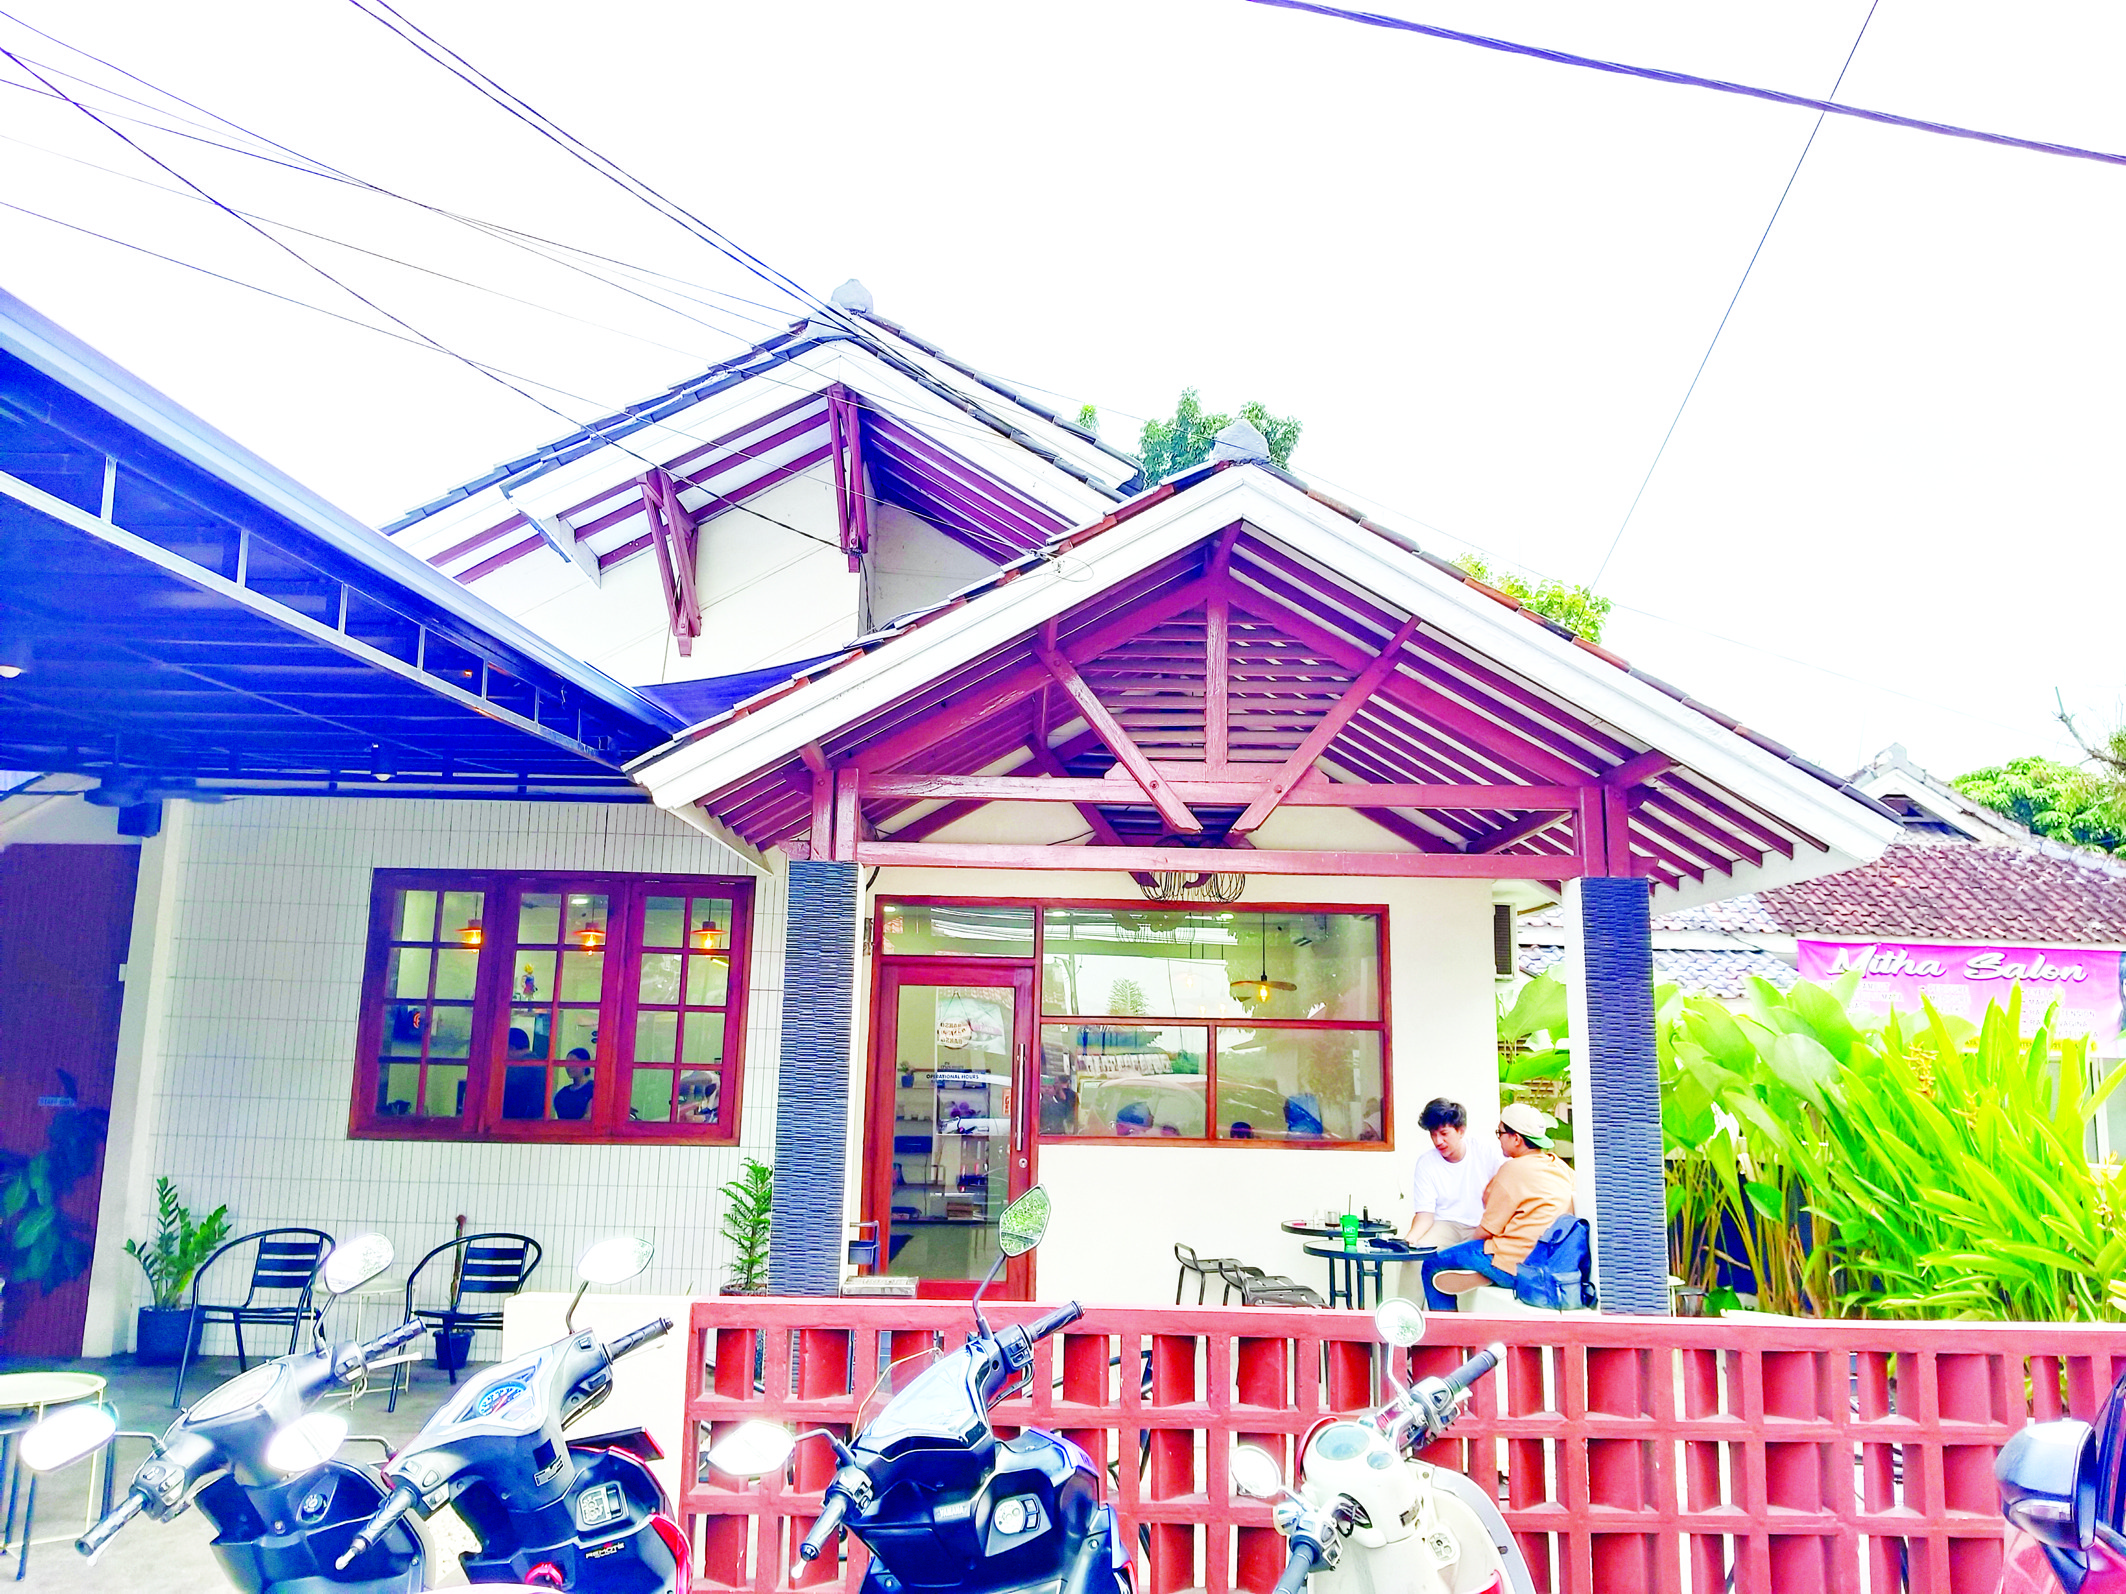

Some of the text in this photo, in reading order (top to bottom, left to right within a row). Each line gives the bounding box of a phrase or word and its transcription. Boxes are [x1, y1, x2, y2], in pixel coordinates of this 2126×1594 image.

[1826, 946, 2088, 982] Mitha Salon
[938, 1505, 967, 1518] YAMAHA
